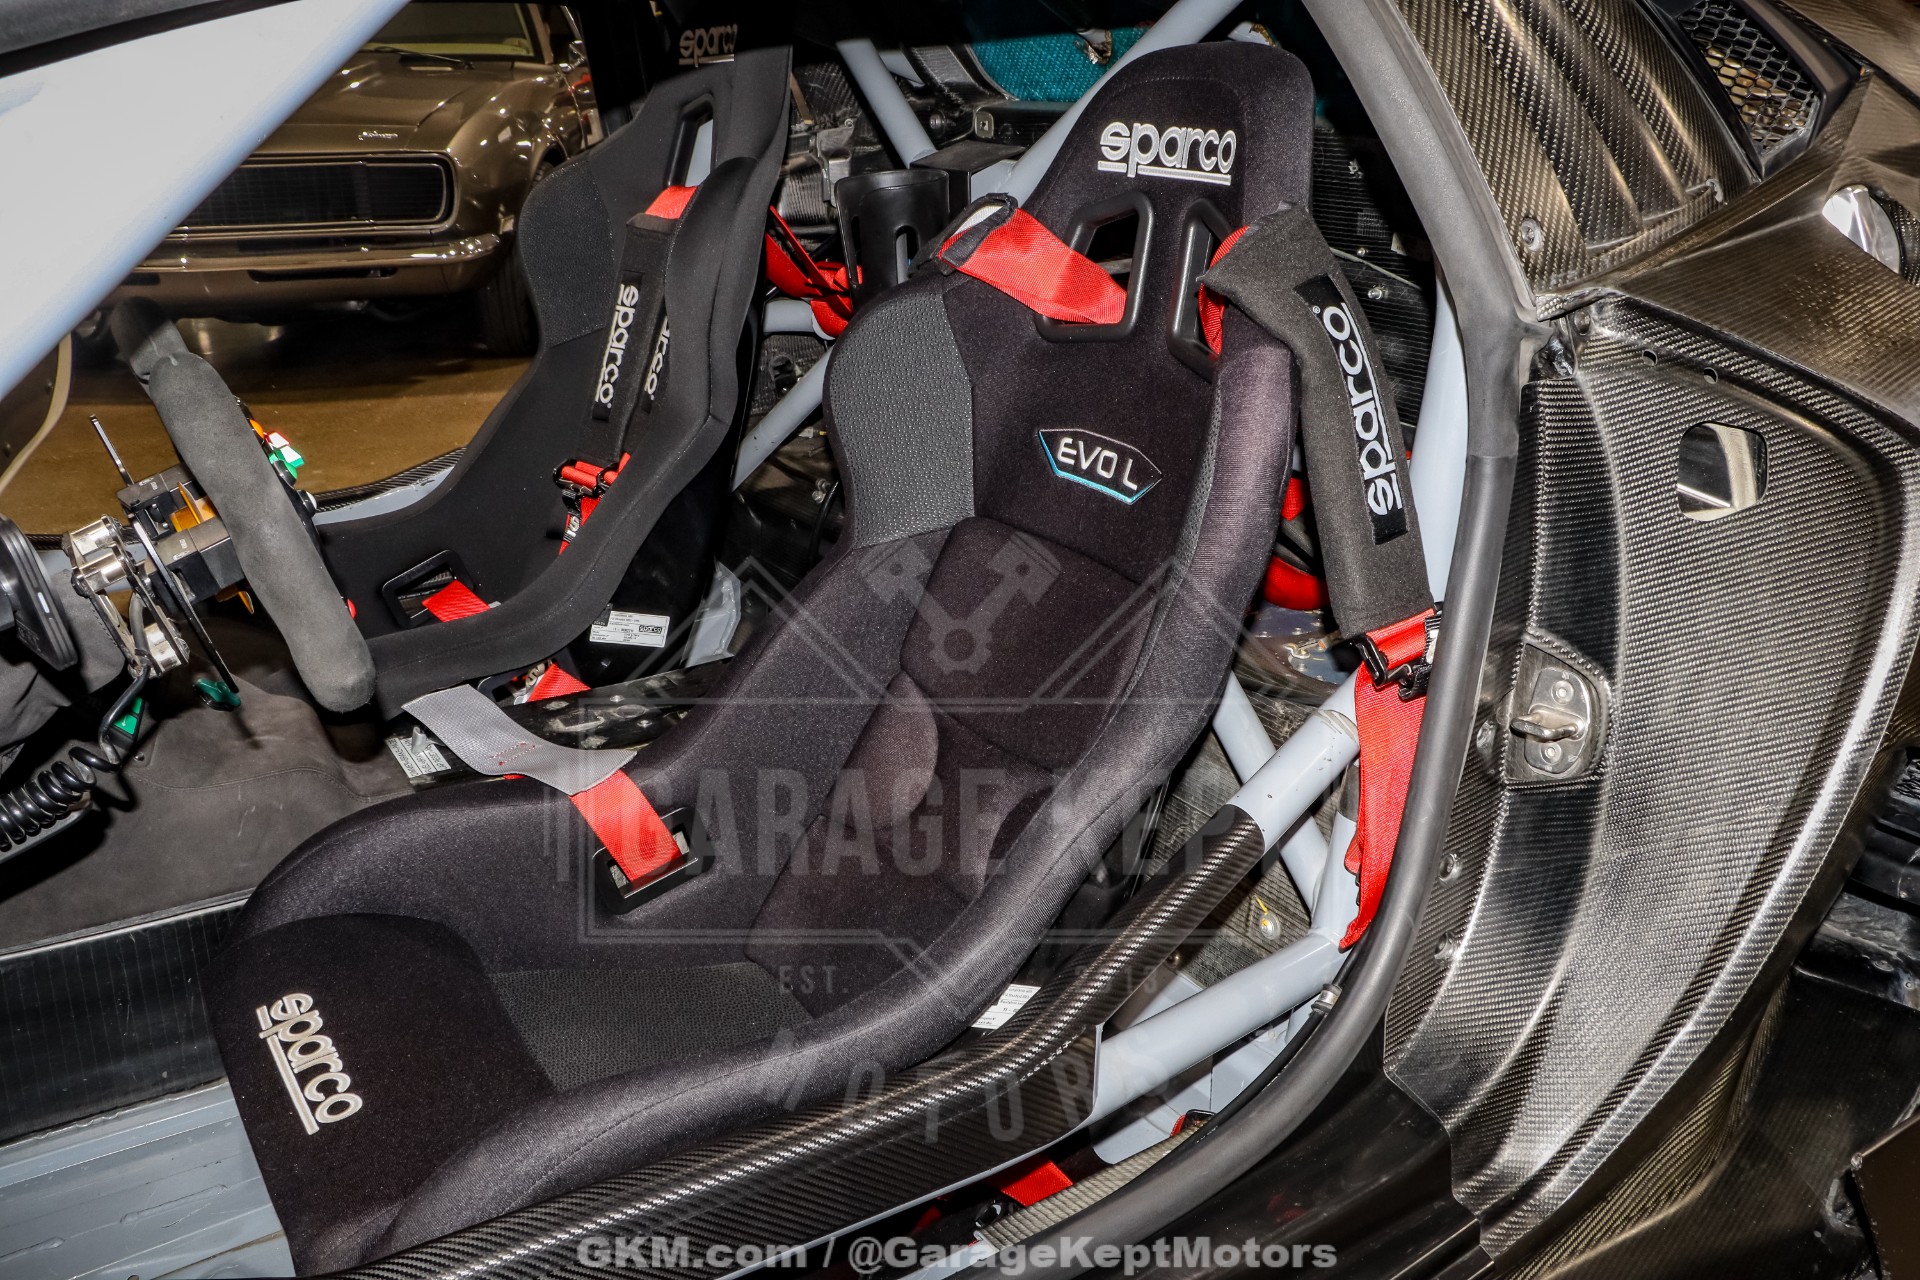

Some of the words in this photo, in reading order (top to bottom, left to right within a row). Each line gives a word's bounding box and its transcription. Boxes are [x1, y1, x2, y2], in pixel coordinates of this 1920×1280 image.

[1098, 122, 1237, 186] sparco
[595, 284, 639, 404] sparco
[1057, 437, 1118, 479] EVO
[1122, 458, 1138, 491] L
[1323, 302, 1403, 516] sparco
[256, 993, 363, 1135] sparco
